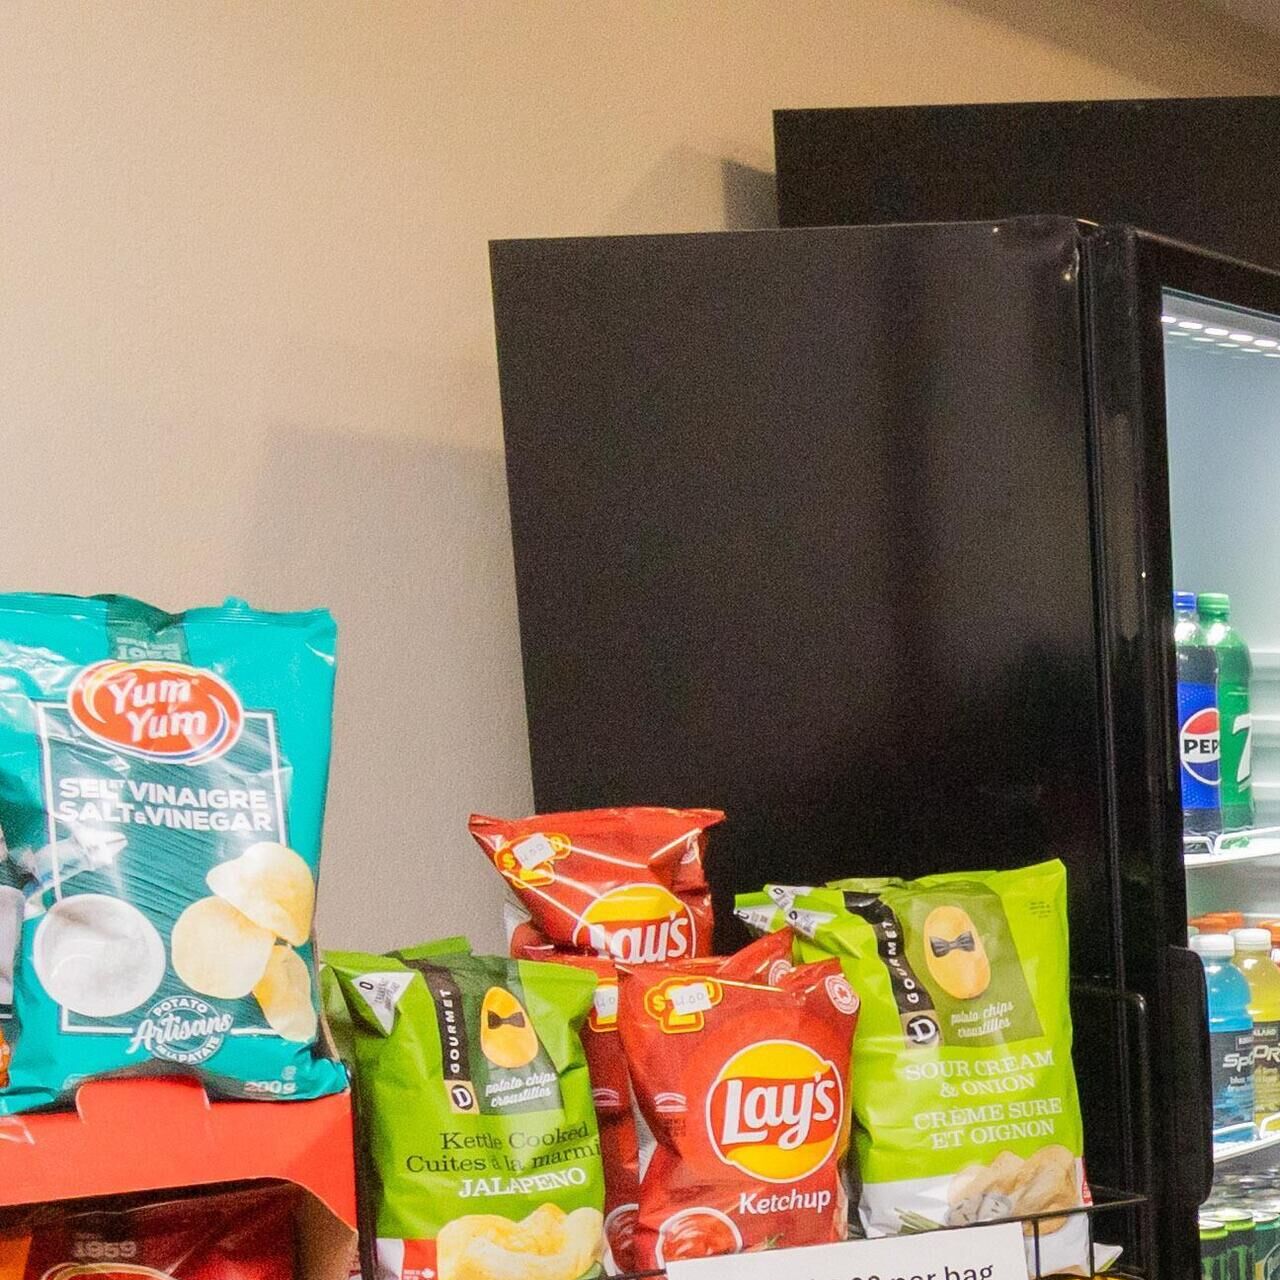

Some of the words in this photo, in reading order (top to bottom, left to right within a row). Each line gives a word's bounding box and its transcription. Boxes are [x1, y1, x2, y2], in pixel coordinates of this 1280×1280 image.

[106, 672, 192, 715] Yum
[126, 707, 207, 743] Yum
[59, 777, 119, 800] SEL
[128, 780, 268, 809] VINAIGRE
[58, 800, 134, 824] SALT
[145, 806, 273, 832] VINEGAR
[884, 919, 920, 1004] GOURMET
[153, 998, 209, 1017] POTATO
[983, 1000, 1014, 1021] chips
[125, 1012, 233, 1054] Artisans
[440, 989, 460, 1073] GOURMET
[911, 1018, 937, 1043] D
[178, 1036, 220, 1063] PATATE
[904, 1058, 970, 1083] SOUR
[974, 1050, 1054, 1076] CREAM
[454, 1088, 473, 1108] D
[485, 1075, 523, 1097] potato
[525, 1070, 556, 1088] chips
[490, 1085, 552, 1107] croustilles
[940, 1080, 959, 1098] &
[961, 1072, 1036, 1096] ONION
[721, 1069, 836, 1150] Lay's
[913, 1103, 1004, 1132] CRÈME
[1008, 1097, 1063, 1122] SURE
[440, 1131, 502, 1151] Kettle
[509, 1121, 590, 1147] Cooked
[931, 1130, 964, 1150] ET
[967, 1118, 1056, 1145] OIGNON
[405, 1153, 486, 1174] Cuites
[504, 1154, 524, 1171] la
[738, 1187, 832, 1215] Ketchup
